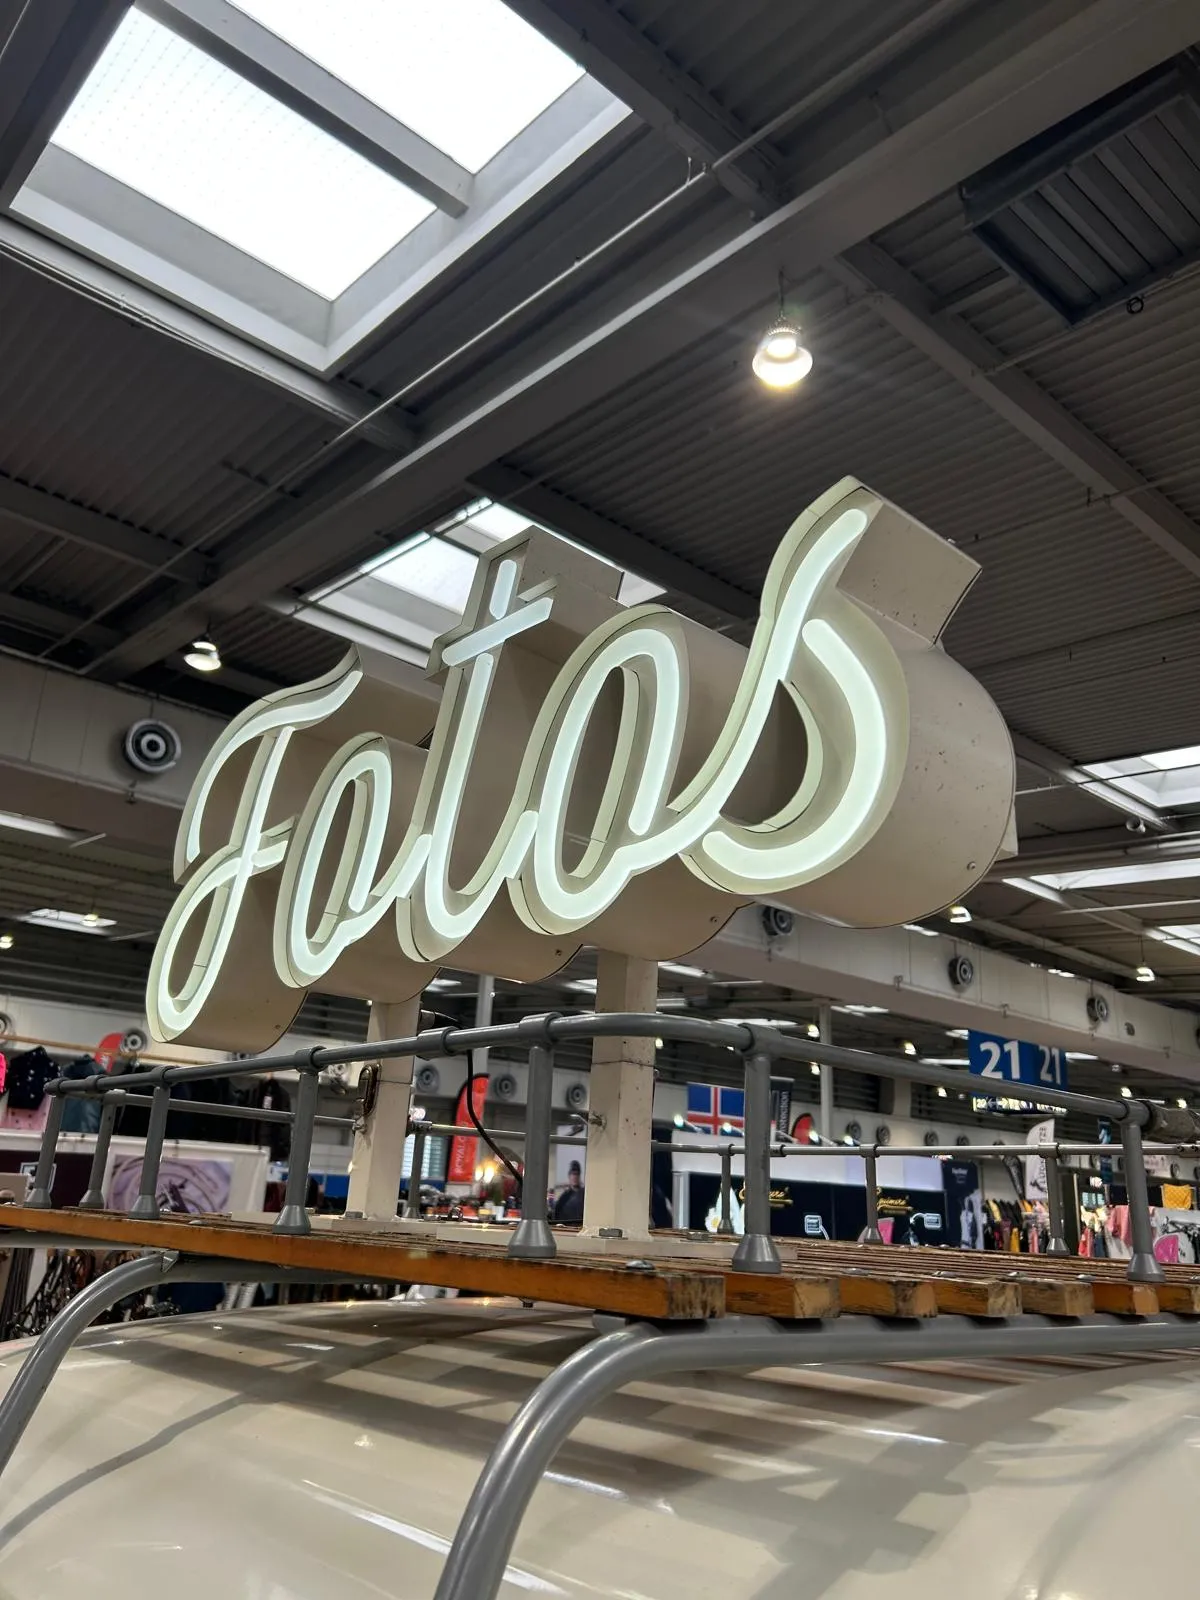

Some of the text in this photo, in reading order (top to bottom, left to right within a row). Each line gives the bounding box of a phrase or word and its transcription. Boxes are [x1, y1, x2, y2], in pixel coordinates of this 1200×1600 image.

[145, 478, 915, 1044] Fotos
[980, 1040, 1020, 1079] 21
[1039, 1045, 1062, 1085] 21
